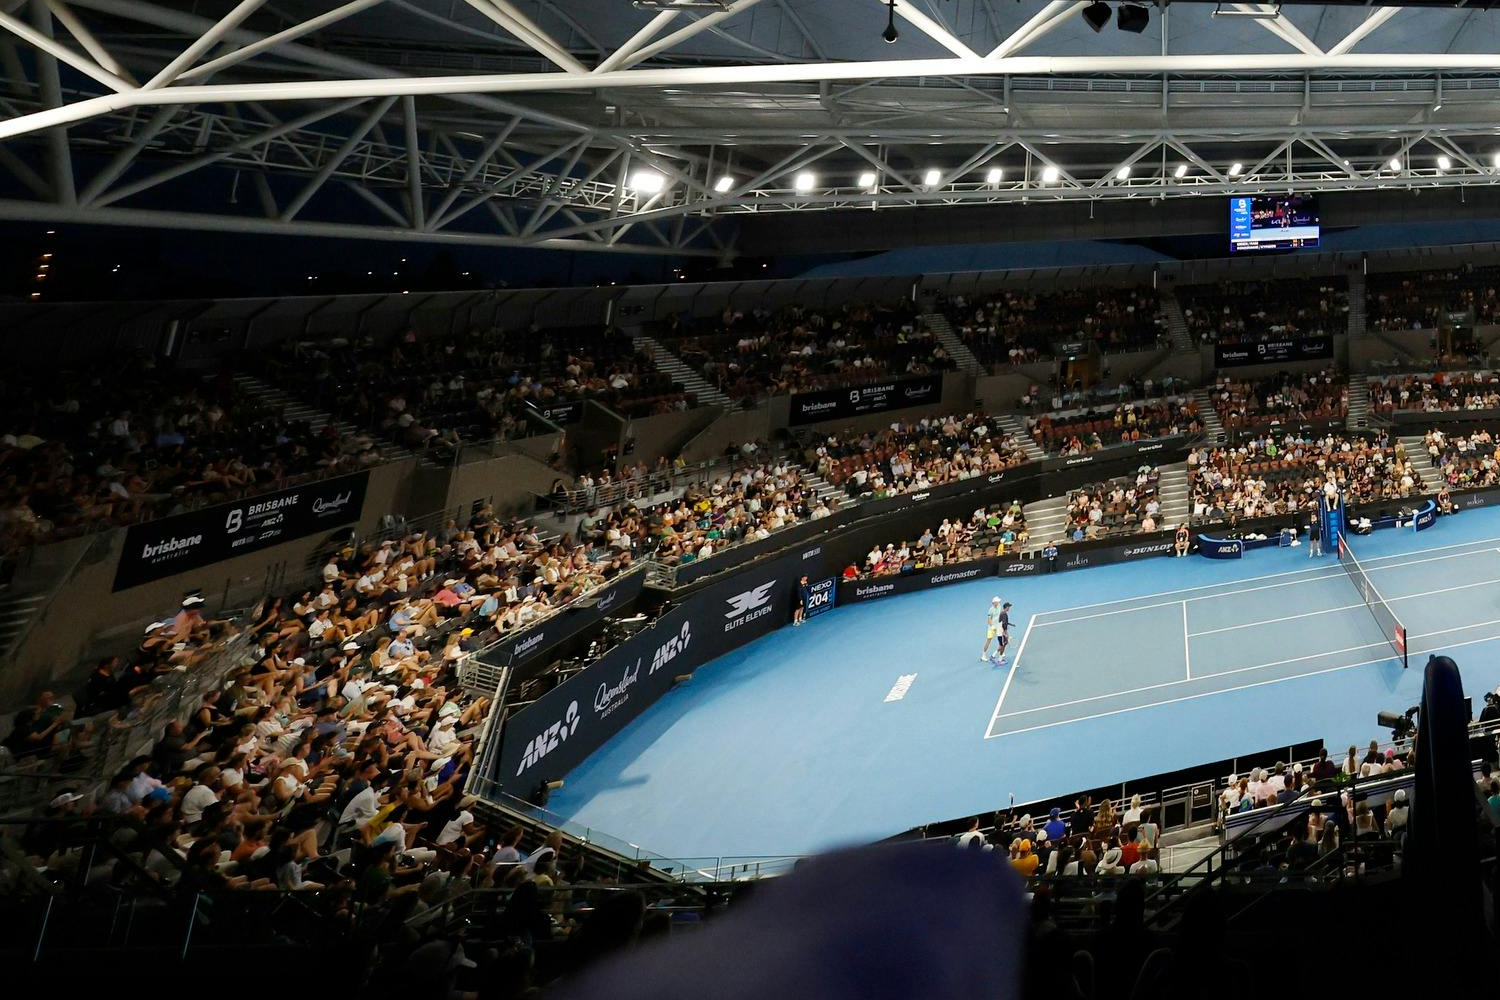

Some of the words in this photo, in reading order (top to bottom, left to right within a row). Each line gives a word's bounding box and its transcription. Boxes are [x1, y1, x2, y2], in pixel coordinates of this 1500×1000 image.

[248, 494, 299, 516] BRISBANE
[142, 534, 202, 559] brisbane
[1131, 543, 1173, 555] DUNLOP
[1066, 553, 1089, 567] sukin
[811, 580, 832, 593] NEXO
[931, 568, 979, 584] ticketmaster
[808, 591, 829, 609] 204
[856, 583, 894, 596] brisbane
[724, 617, 745, 632] ELITE
[745, 604, 773, 623] ELEVEN
[649, 635, 680, 675] ANZ
[594, 657, 642, 712] Queensland
[600, 693, 629, 720] AUSTRALIA
[516, 719, 562, 777] ANZ
